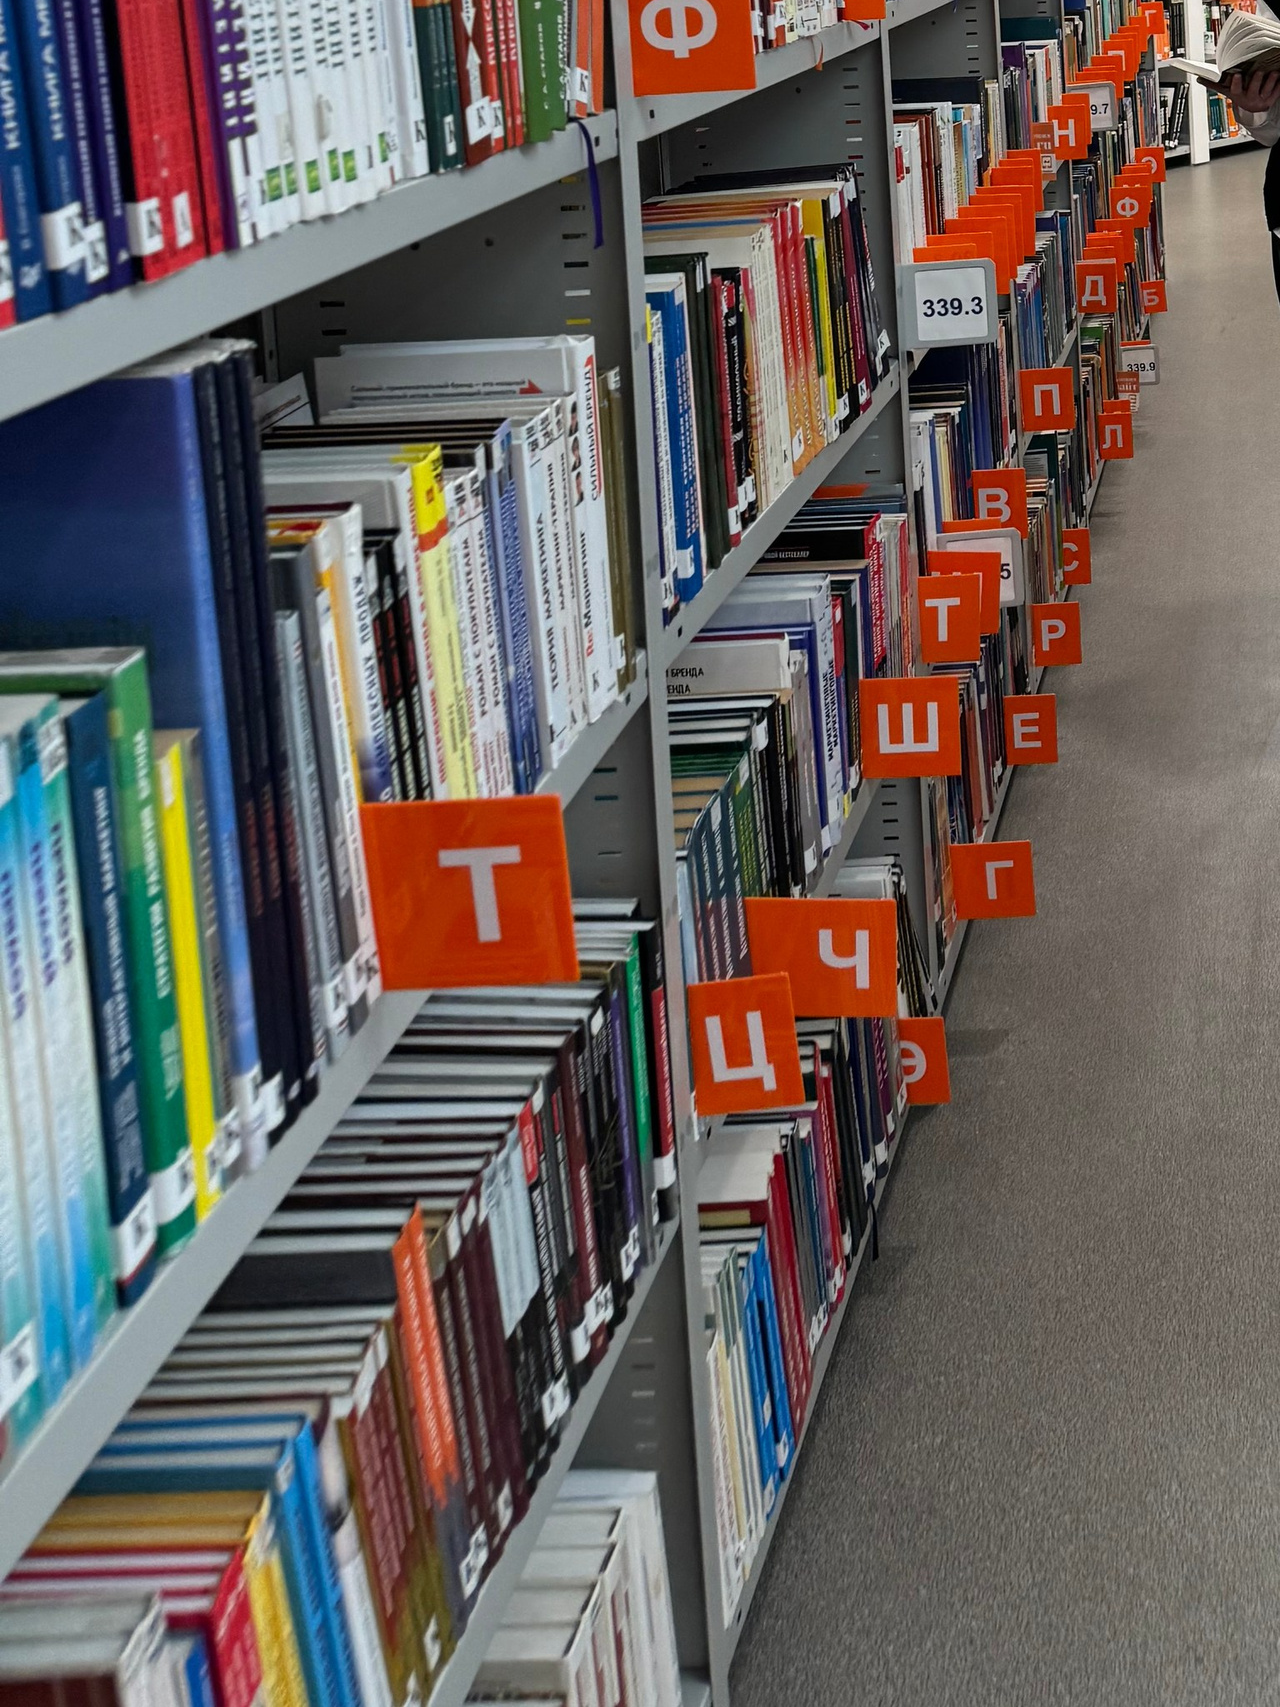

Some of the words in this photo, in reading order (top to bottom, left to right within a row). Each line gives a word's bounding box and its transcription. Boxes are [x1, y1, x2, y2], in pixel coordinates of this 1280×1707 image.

[36, 44, 66, 141] КНИГА
[579, 73, 588, 95] К
[1053, 119, 1075, 146] Н
[1116, 196, 1139, 217] Ф
[923, 296, 984, 319] 339.3
[1081, 275, 1106, 306] Д
[1143, 289, 1160, 307] Б
[1127, 361, 1156, 373] 339.9
[582, 369, 594, 422] БРЕНД
[1033, 384, 1061, 417] П
[1102, 424, 1123, 449] Л
[584, 423, 600, 502] СИЛЬНЫЙ
[978, 488, 1011, 523] В
[547, 463, 565, 612] МАРКЕТИНГ-ТЕРАПИЯ
[535, 513, 553, 621] МАРКЕТИНГА
[351, 574, 374, 645] ПРОДАЖ
[462, 537, 480, 645] ПОКУПАТЕЛЕМ
[925, 597, 961, 643] Т
[1041, 619, 1066, 652] Р
[488, 653, 501, 708] РОМАН
[545, 627, 559, 692] ТЕОРИЯ
[670, 667, 704, 679] БРЕНДА
[475, 665, 489, 718] РОМАН
[877, 701, 940, 754] Ш
[1012, 713, 1041, 749] Е
[438, 844, 522, 943] Т
[985, 860, 1014, 900] Г
[818, 928, 871, 990] Ч
[705, 1010, 777, 1091] Ц
